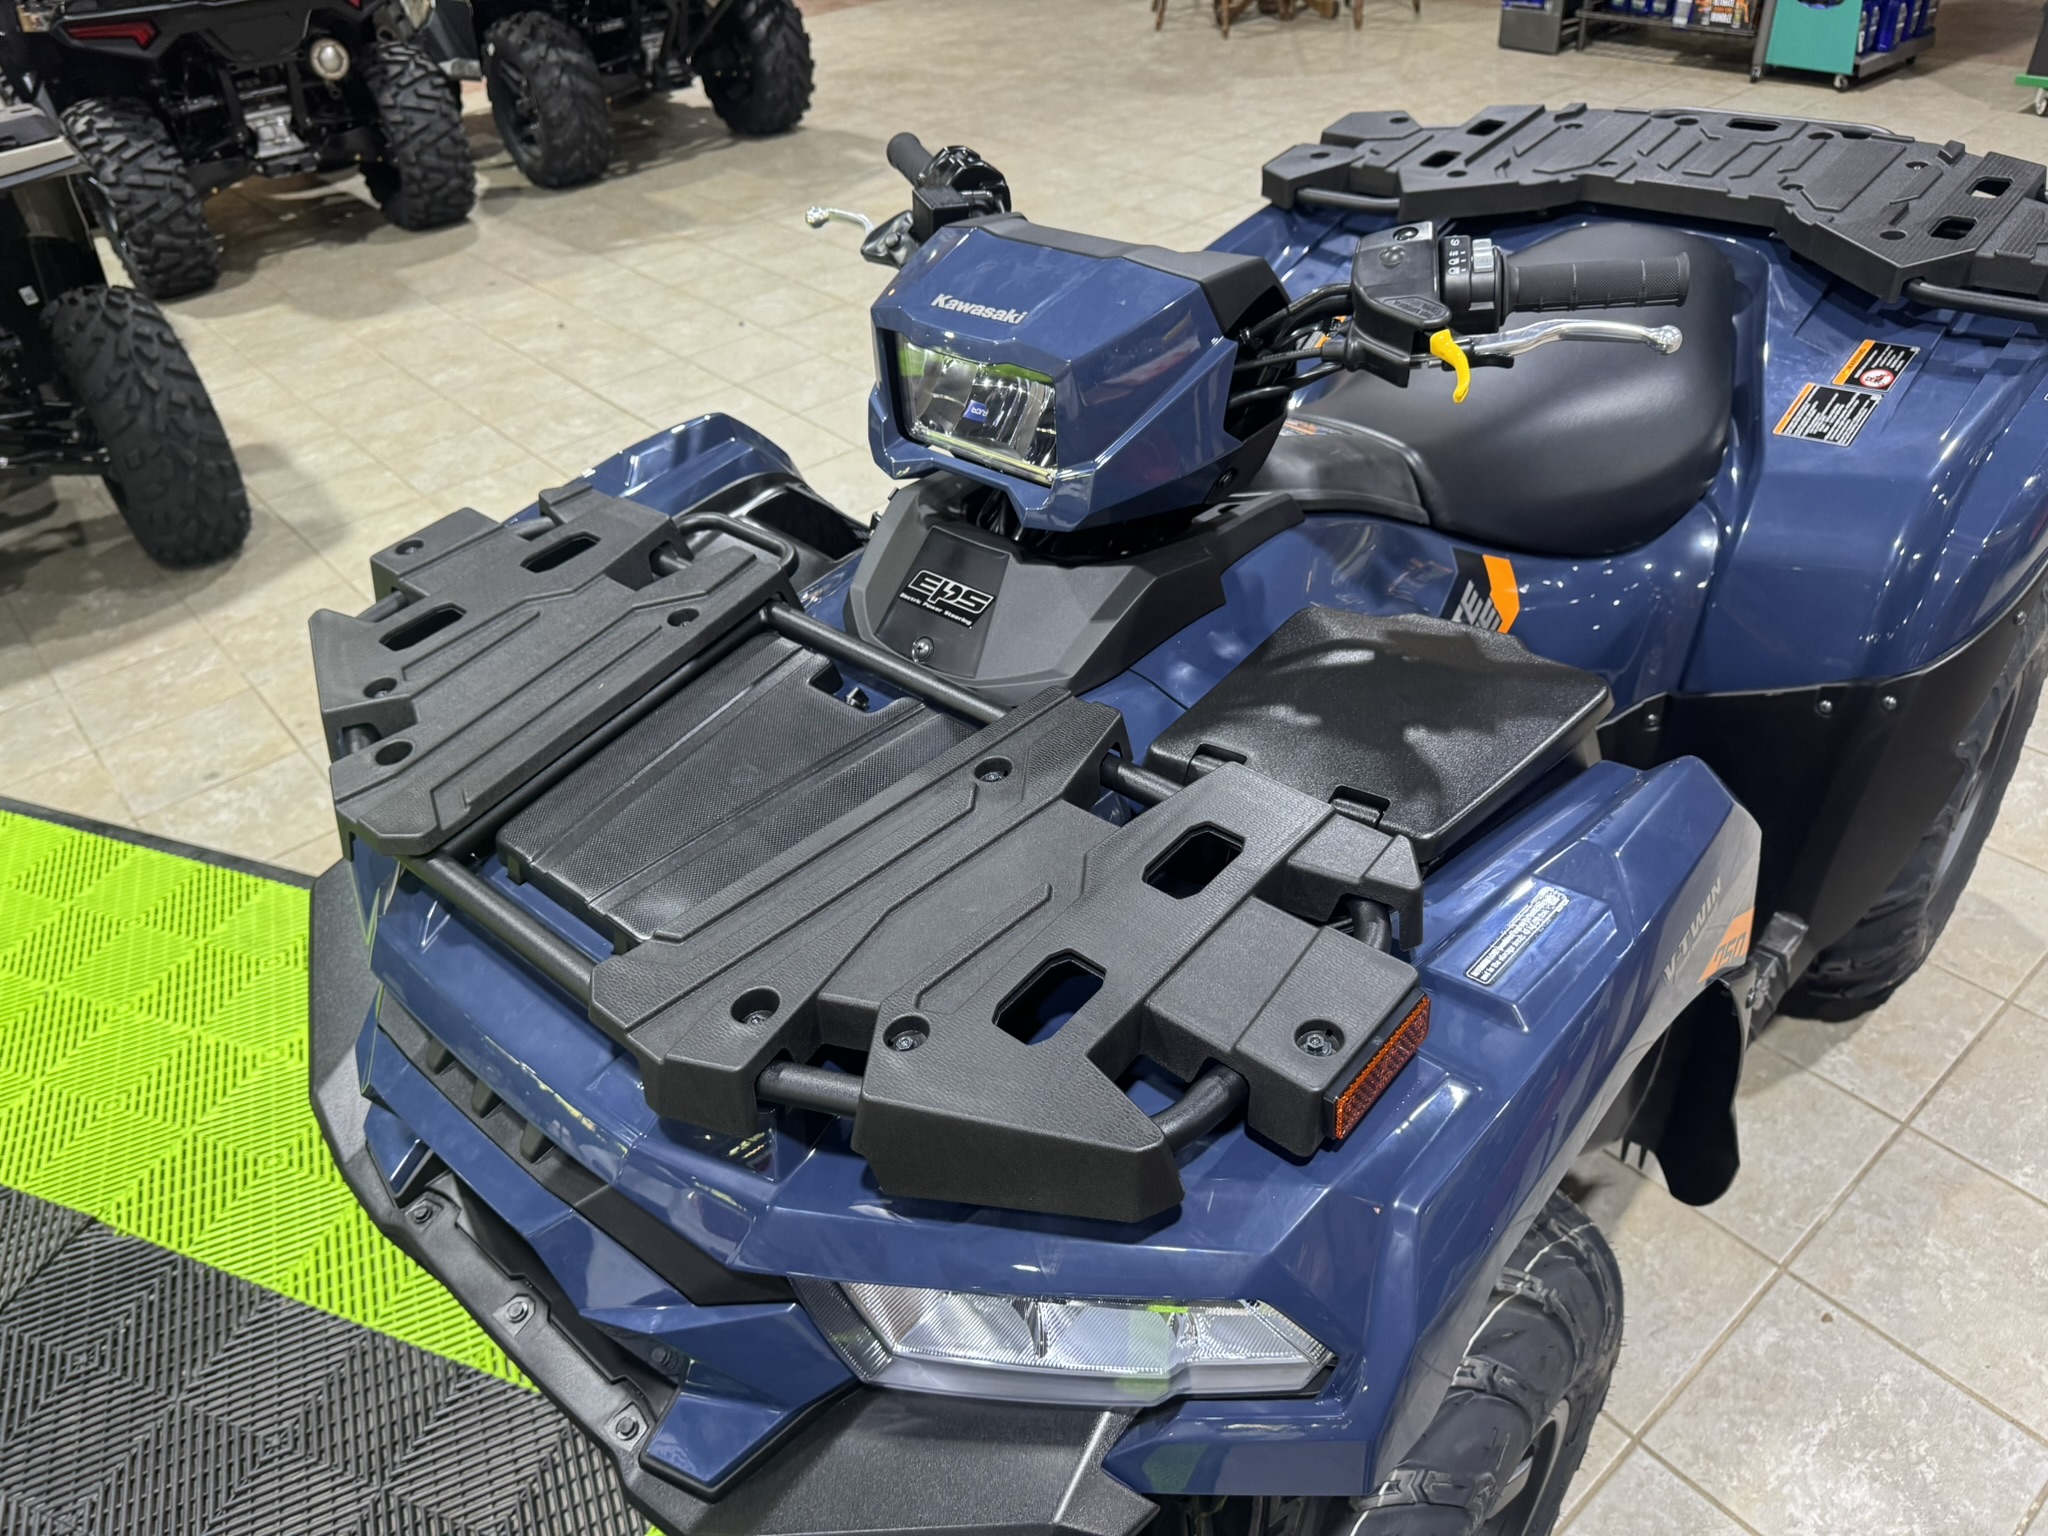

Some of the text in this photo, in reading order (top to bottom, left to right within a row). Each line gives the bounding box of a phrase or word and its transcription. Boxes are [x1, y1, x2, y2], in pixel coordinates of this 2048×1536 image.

[930, 293, 1028, 325] Kawasaki
[899, 592, 973, 626] Electric Power Steering
[907, 569, 995, 615] EPS
[1663, 876, 1722, 983] V-TWIN
